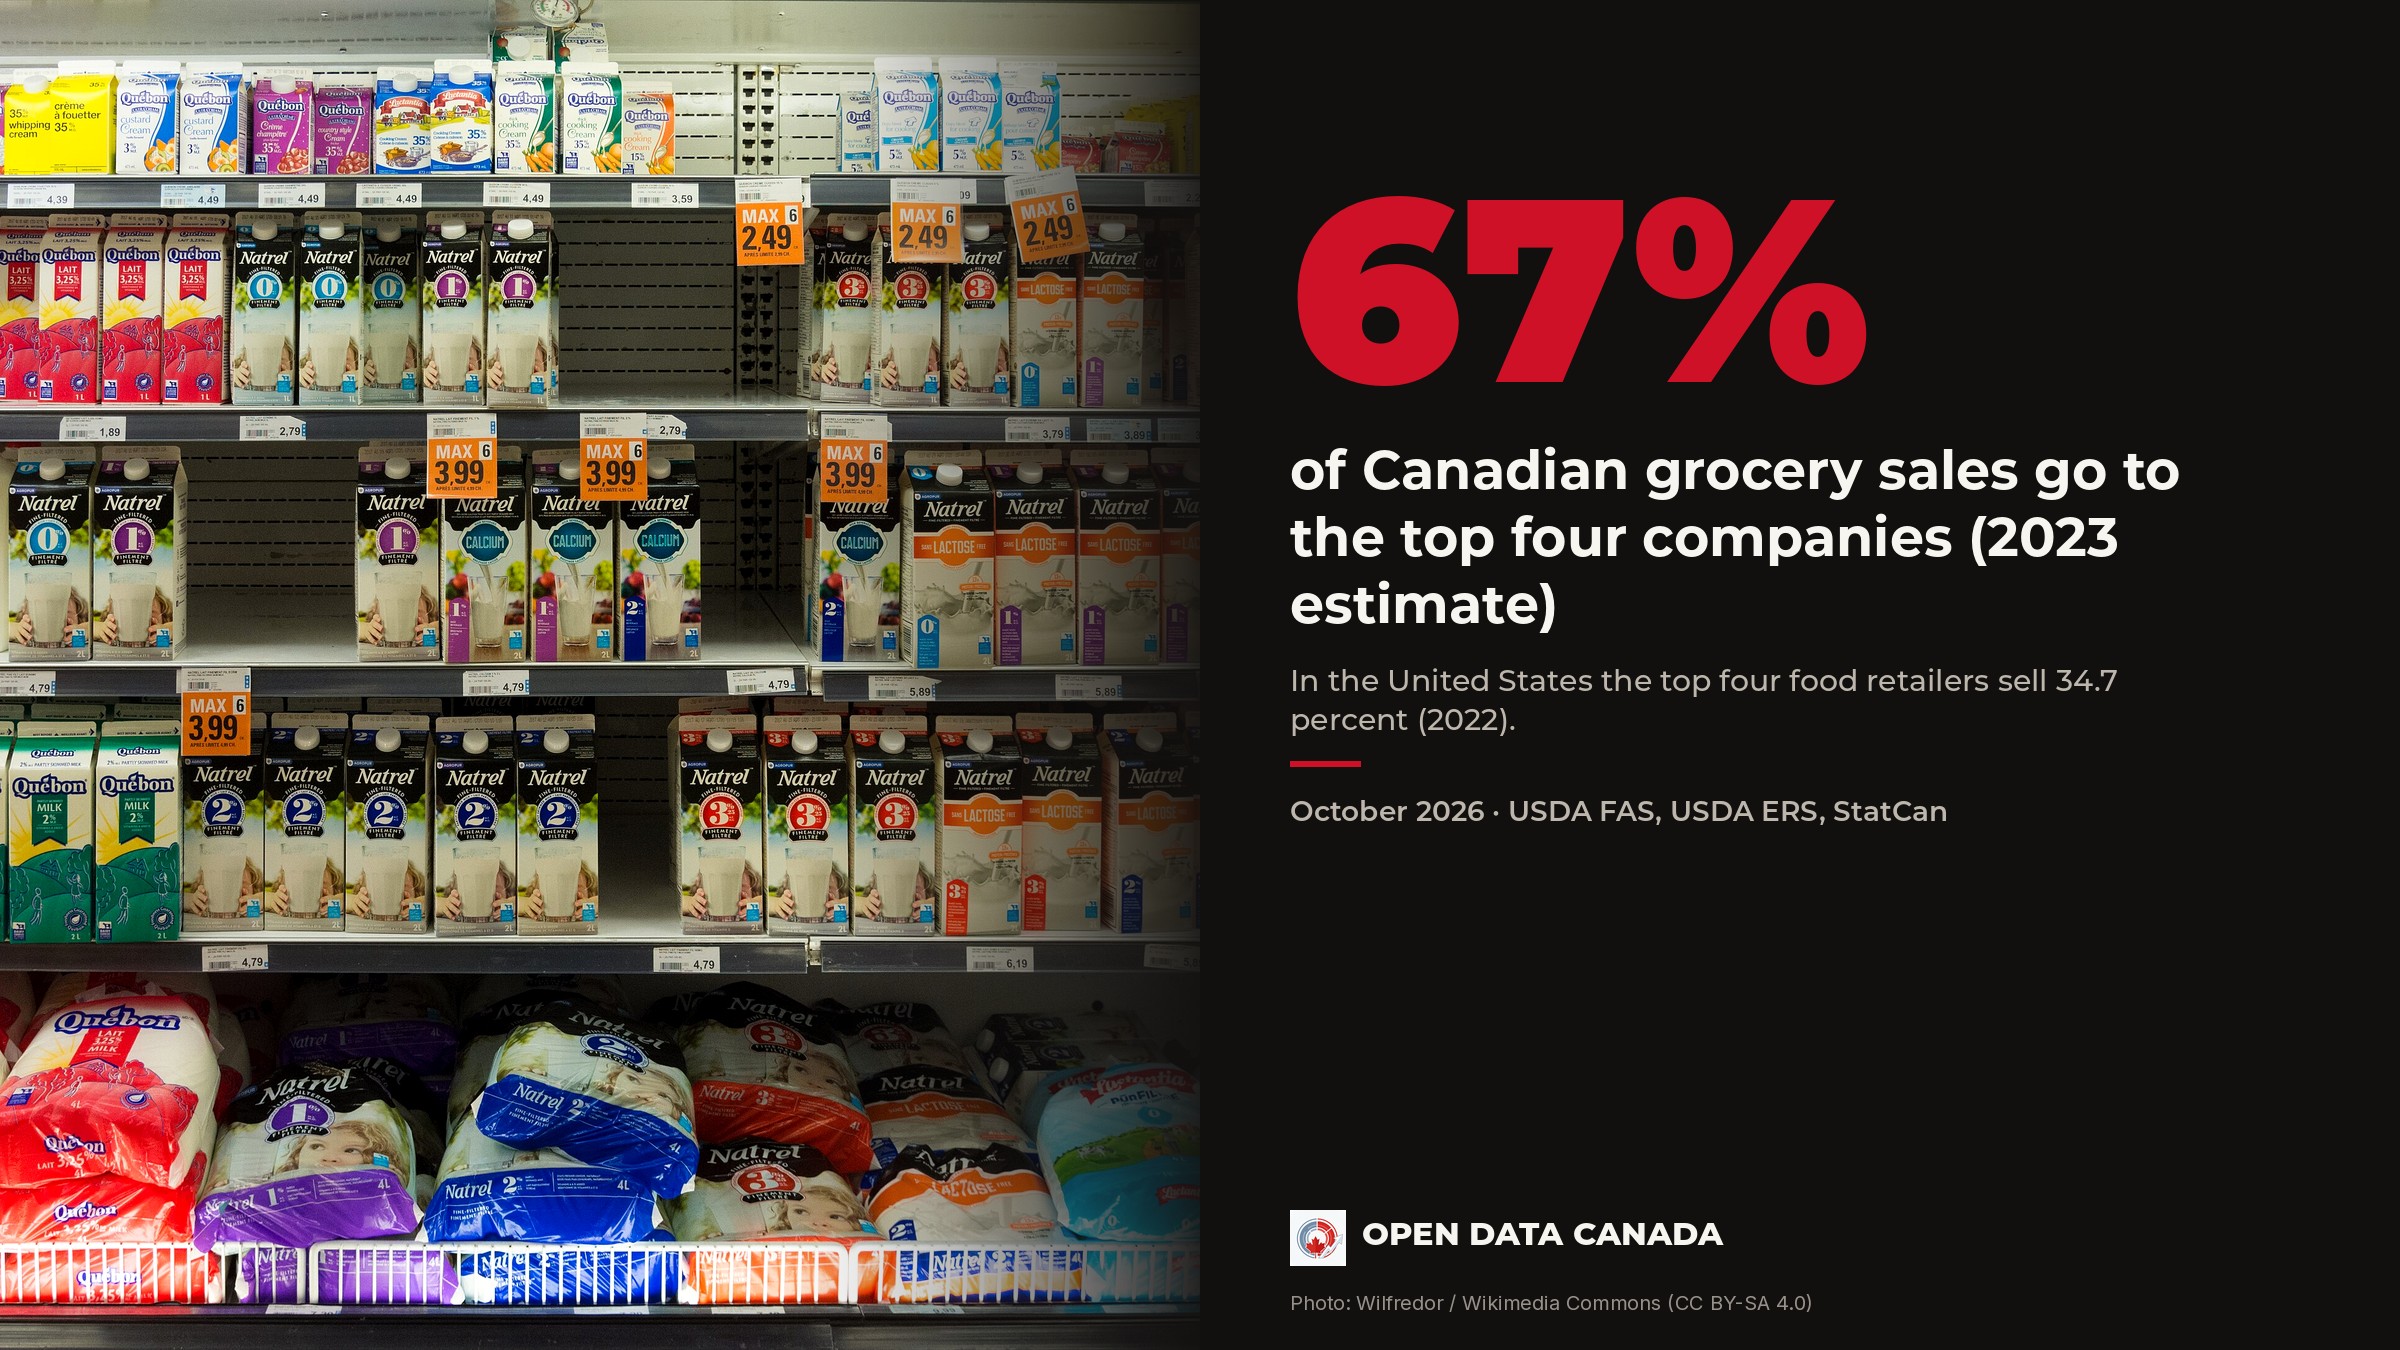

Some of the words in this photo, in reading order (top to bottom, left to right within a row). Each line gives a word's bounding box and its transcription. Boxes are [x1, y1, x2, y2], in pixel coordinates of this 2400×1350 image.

[121, 90, 170, 106] Québon
[184, 91, 233, 107] Québon
[388, 97, 423, 107] Lactantia
[442, 89, 478, 101] Lactantia
[499, 91, 548, 107] Québon
[568, 91, 617, 107] Québon
[883, 89, 934, 105] Québon
[948, 89, 998, 105] Québon
[1006, 90, 1055, 106] Québon
[54, 101, 85, 110] crème
[258, 98, 304, 113] Québon
[319, 102, 365, 118] Québon
[62, 111, 102, 119] fouetter
[120, 115, 151, 124] custard
[625, 108, 669, 122] Québon
[9, 121, 51, 130] whipping
[120, 124, 151, 135] Cream
[497, 121, 529, 130] cooking
[498, 129, 527, 138] Cream
[623, 136, 652, 144] cooking
[624, 142, 651, 151] Cream
[46, 195, 68, 205] 4,39
[198, 196, 219, 206] 4,49
[298, 194, 319, 204] 4,49
[396, 194, 418, 204] 4,49
[523, 194, 544, 204] 4,49
[672, 194, 693, 204] 3,59
[742, 208, 779, 223] MAX
[789, 208, 797, 222] 6
[899, 208, 937, 223] MAX
[945, 209, 955, 223] 6
[1020, 202, 1058, 221] MAX
[1066, 198, 1075, 212] 6
[742, 224, 792, 252] 2,49
[899, 224, 948, 249] 2,49
[1023, 214, 1074, 247] 2,49
[106, 246, 160, 263] Québon
[167, 246, 221, 262] Québon
[304, 250, 353, 265] Natrel
[493, 249, 542, 264] Natrel
[122, 265, 142, 273] LAIT
[183, 265, 202, 273] LAIT
[100, 427, 121, 438] 1,89
[279, 426, 300, 437] 2,79
[1043, 429, 1064, 439] 3,79
[1124, 430, 1145, 440] 3,89
[436, 444, 473, 459] MAX
[482, 444, 490, 457] 6
[827, 445, 863, 460] MAX
[874, 446, 882, 461] 6
[434, 460, 484, 486] 3,99
[825, 461, 875, 488] 3,99
[18, 495, 78, 512] Natrel
[103, 494, 163, 512] Natrel
[924, 500, 983, 517] Natrel
[465, 535, 505, 550] CALCIUM
[553, 534, 592, 549] CALCIUM
[933, 540, 975, 554] LACTOSE
[29, 683, 50, 694] 4,79
[502, 682, 524, 692] 4,79
[768, 680, 790, 690] 4,79
[909, 687, 931, 697] 5,89
[1095, 687, 1116, 697] 5,89
[190, 699, 226, 713] MAX
[236, 698, 244, 713] 6
[189, 714, 238, 742] 3,99
[117, 747, 160, 757] Québon
[100, 771, 175, 797] Québon
[446, 769, 505, 786] Natrel
[690, 768, 750, 785] Natrel
[954, 768, 1012, 786] Natrel
[701, 786, 740, 798] FINE-FILTERED
[124, 801, 150, 811] MILK
[963, 808, 1005, 822] LACTOSE
[242, 957, 263, 968] 4,79
[693, 959, 715, 970] 4,79
[1006, 958, 1028, 969] 6,19
[54, 1004, 181, 1034] Québon
[255, 1068, 349, 1106] Natrel
[880, 1074, 964, 1092] Natrel
[512, 1083, 565, 1111] Natrel
[708, 1142, 800, 1164] Natrel
[445, 1181, 492, 1200] Natrel
[616, 1179, 630, 1191] 4L
[932, 1180, 997, 1197] LACTOSE
